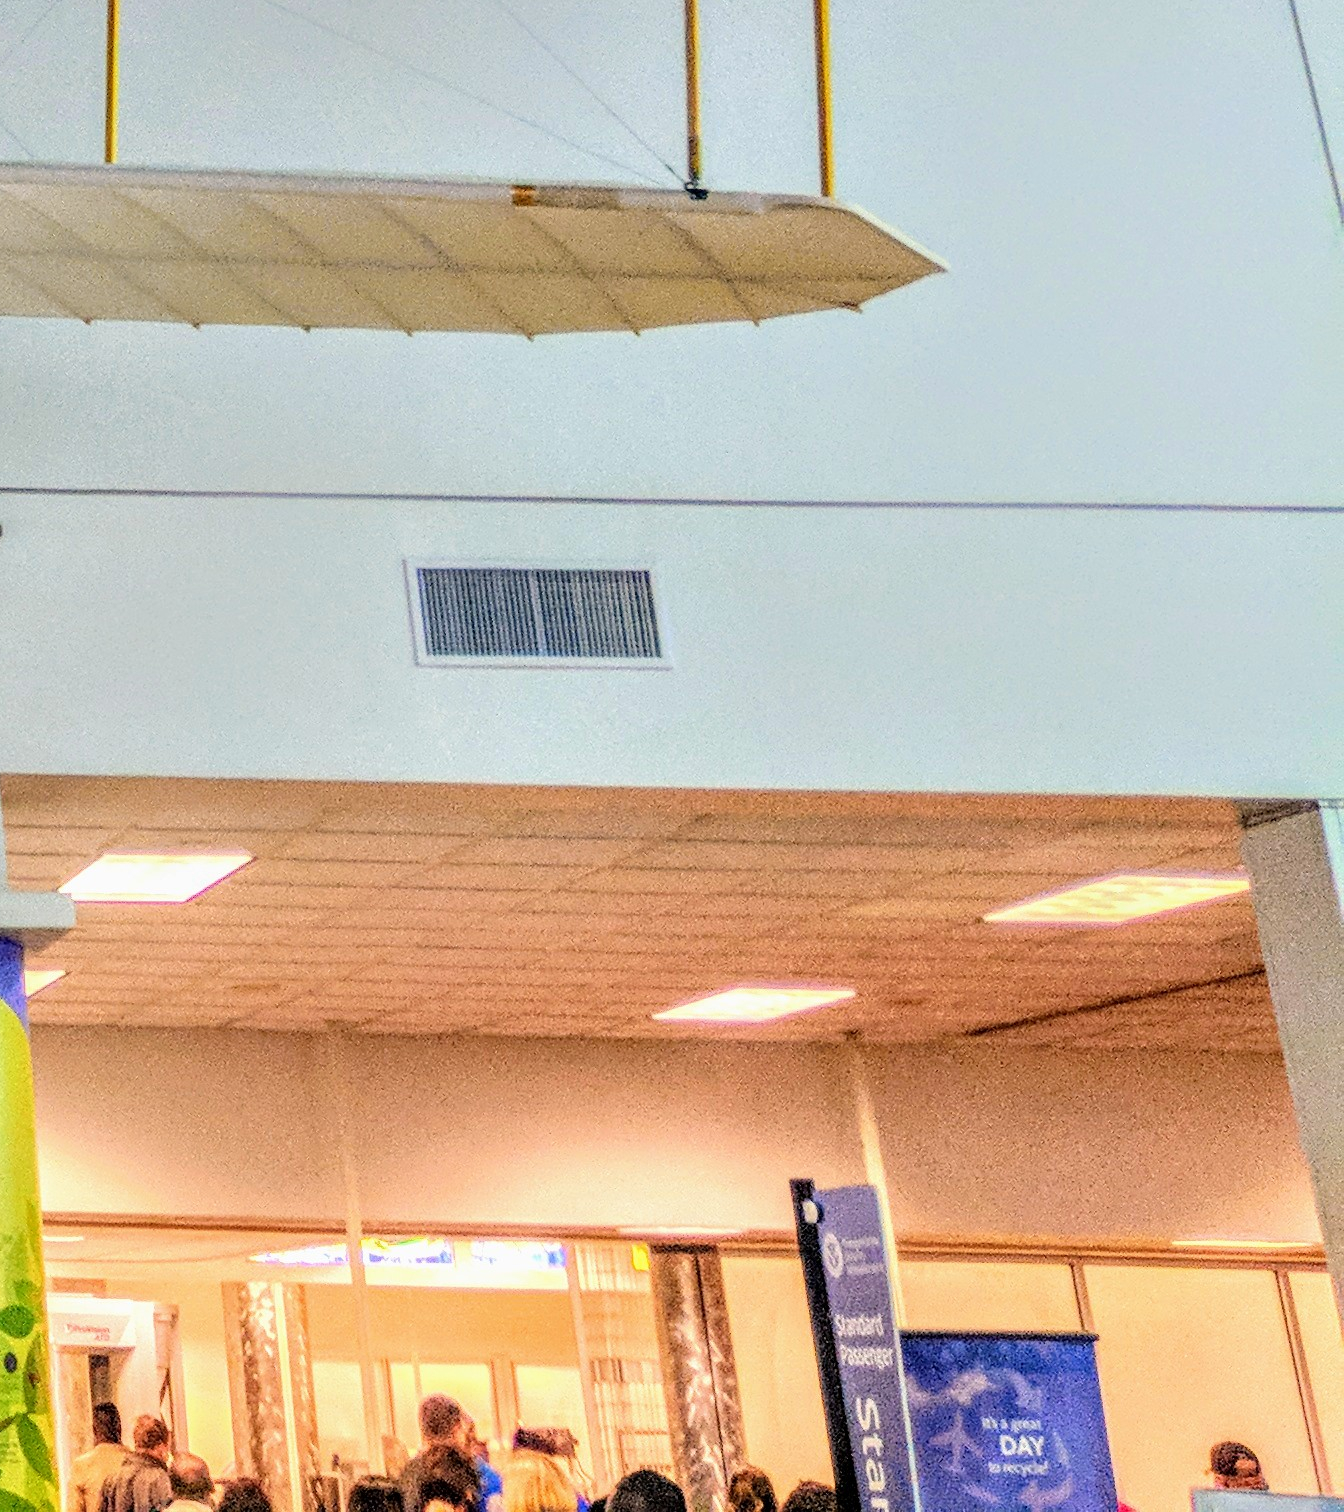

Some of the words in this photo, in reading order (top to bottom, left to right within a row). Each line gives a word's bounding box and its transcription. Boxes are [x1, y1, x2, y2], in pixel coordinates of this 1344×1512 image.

[835, 1313, 885, 1337] Standard
[839, 1344, 894, 1371] Passenger
[999, 1433, 1045, 1457] DAY
